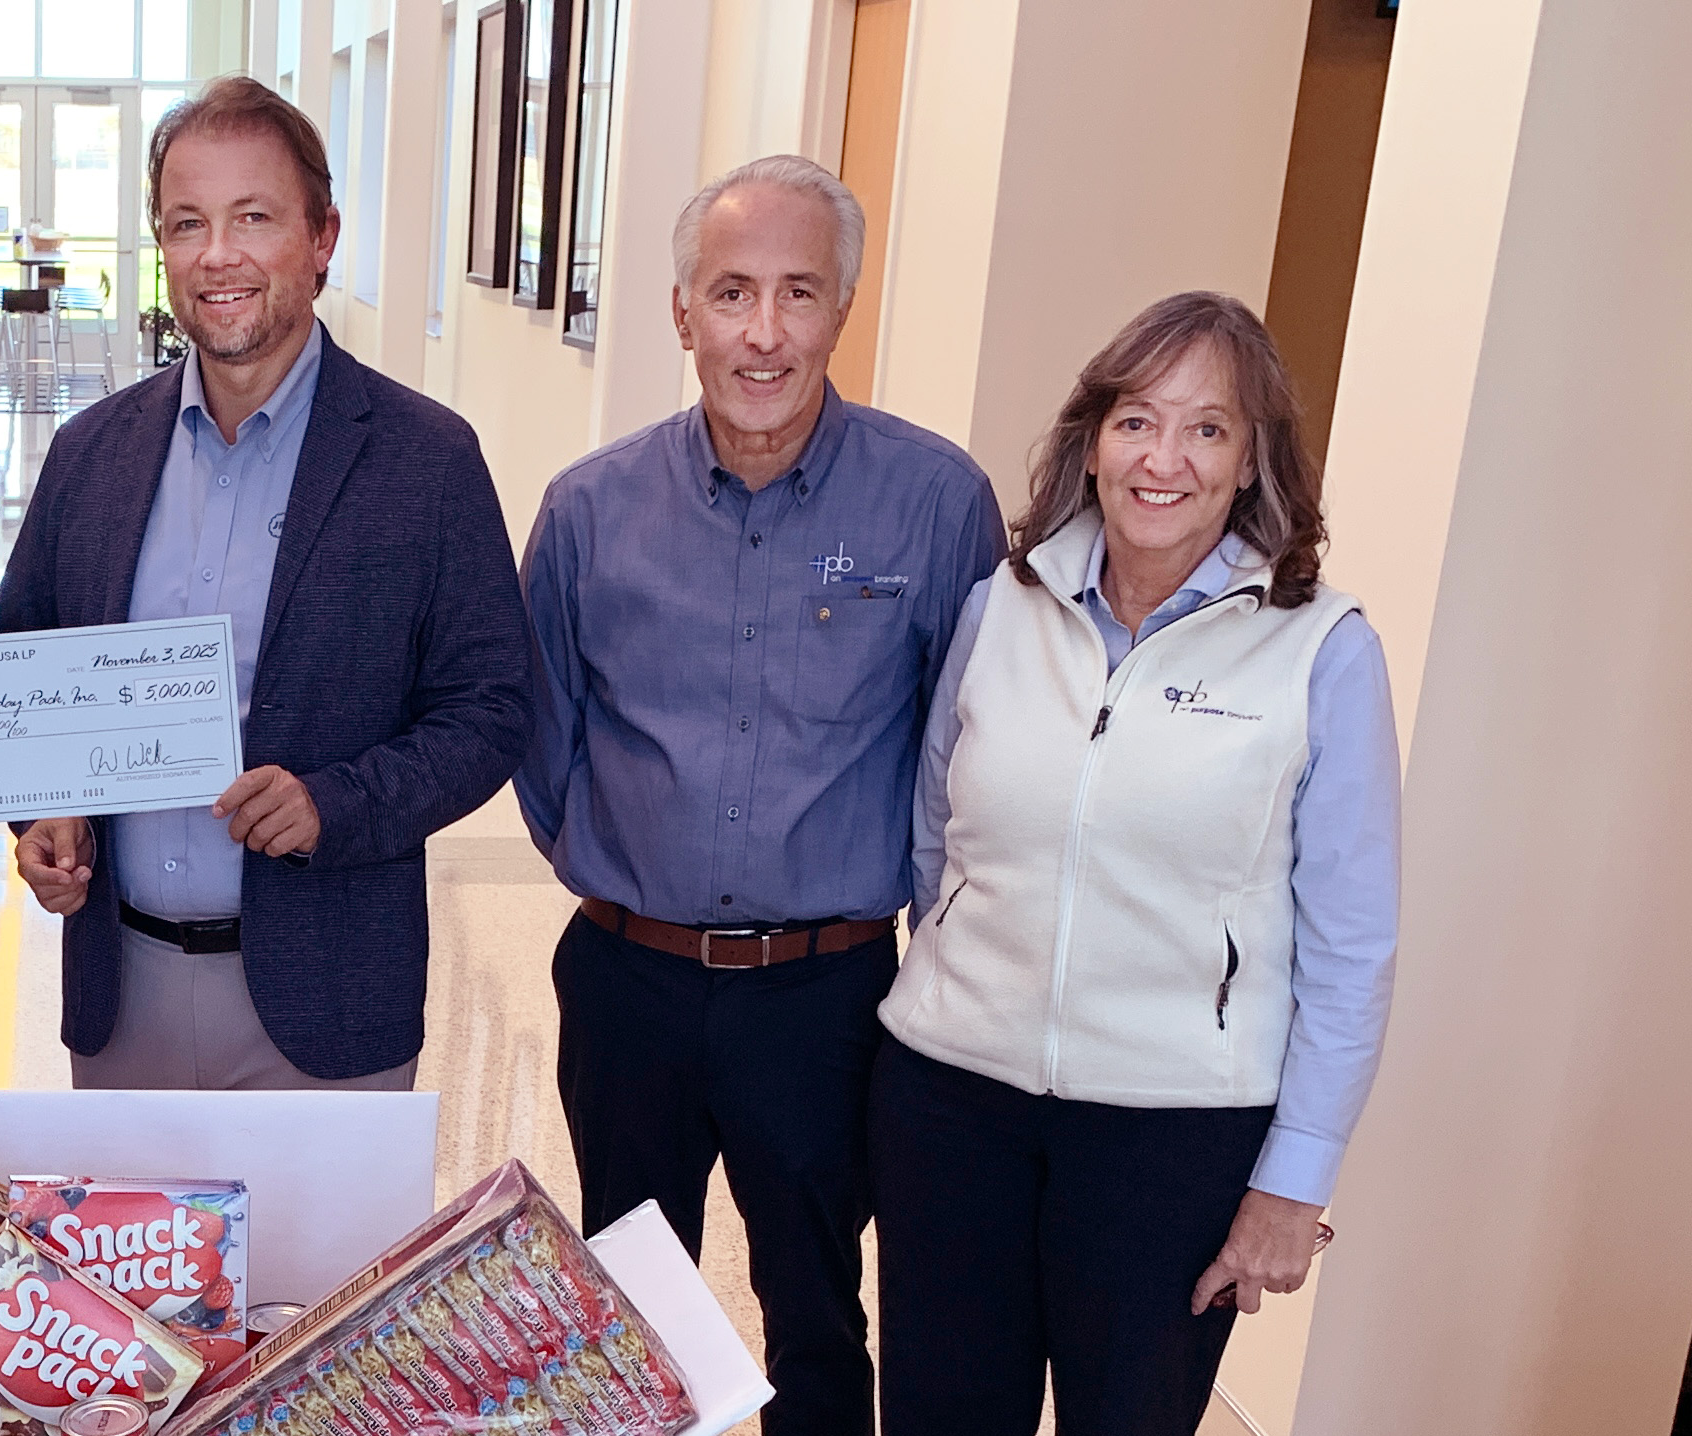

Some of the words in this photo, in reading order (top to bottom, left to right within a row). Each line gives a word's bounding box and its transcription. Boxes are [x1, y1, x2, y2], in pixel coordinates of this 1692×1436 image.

[874, 575, 908, 584] branding
[21, 650, 36, 659] LP
[91, 648, 158, 668] November
[162, 648, 174, 663] 3,
[180, 642, 220, 659] 2025
[27, 689, 66, 707] Pack,
[71, 686, 98, 704] Inc.
[119, 685, 133, 706] $
[145, 679, 216, 701] 5,000.00
[189, 715, 223, 724] DOLLARS
[116, 773, 161, 782] AUTHORIZED
[163, 770, 202, 778] SIGNATURE
